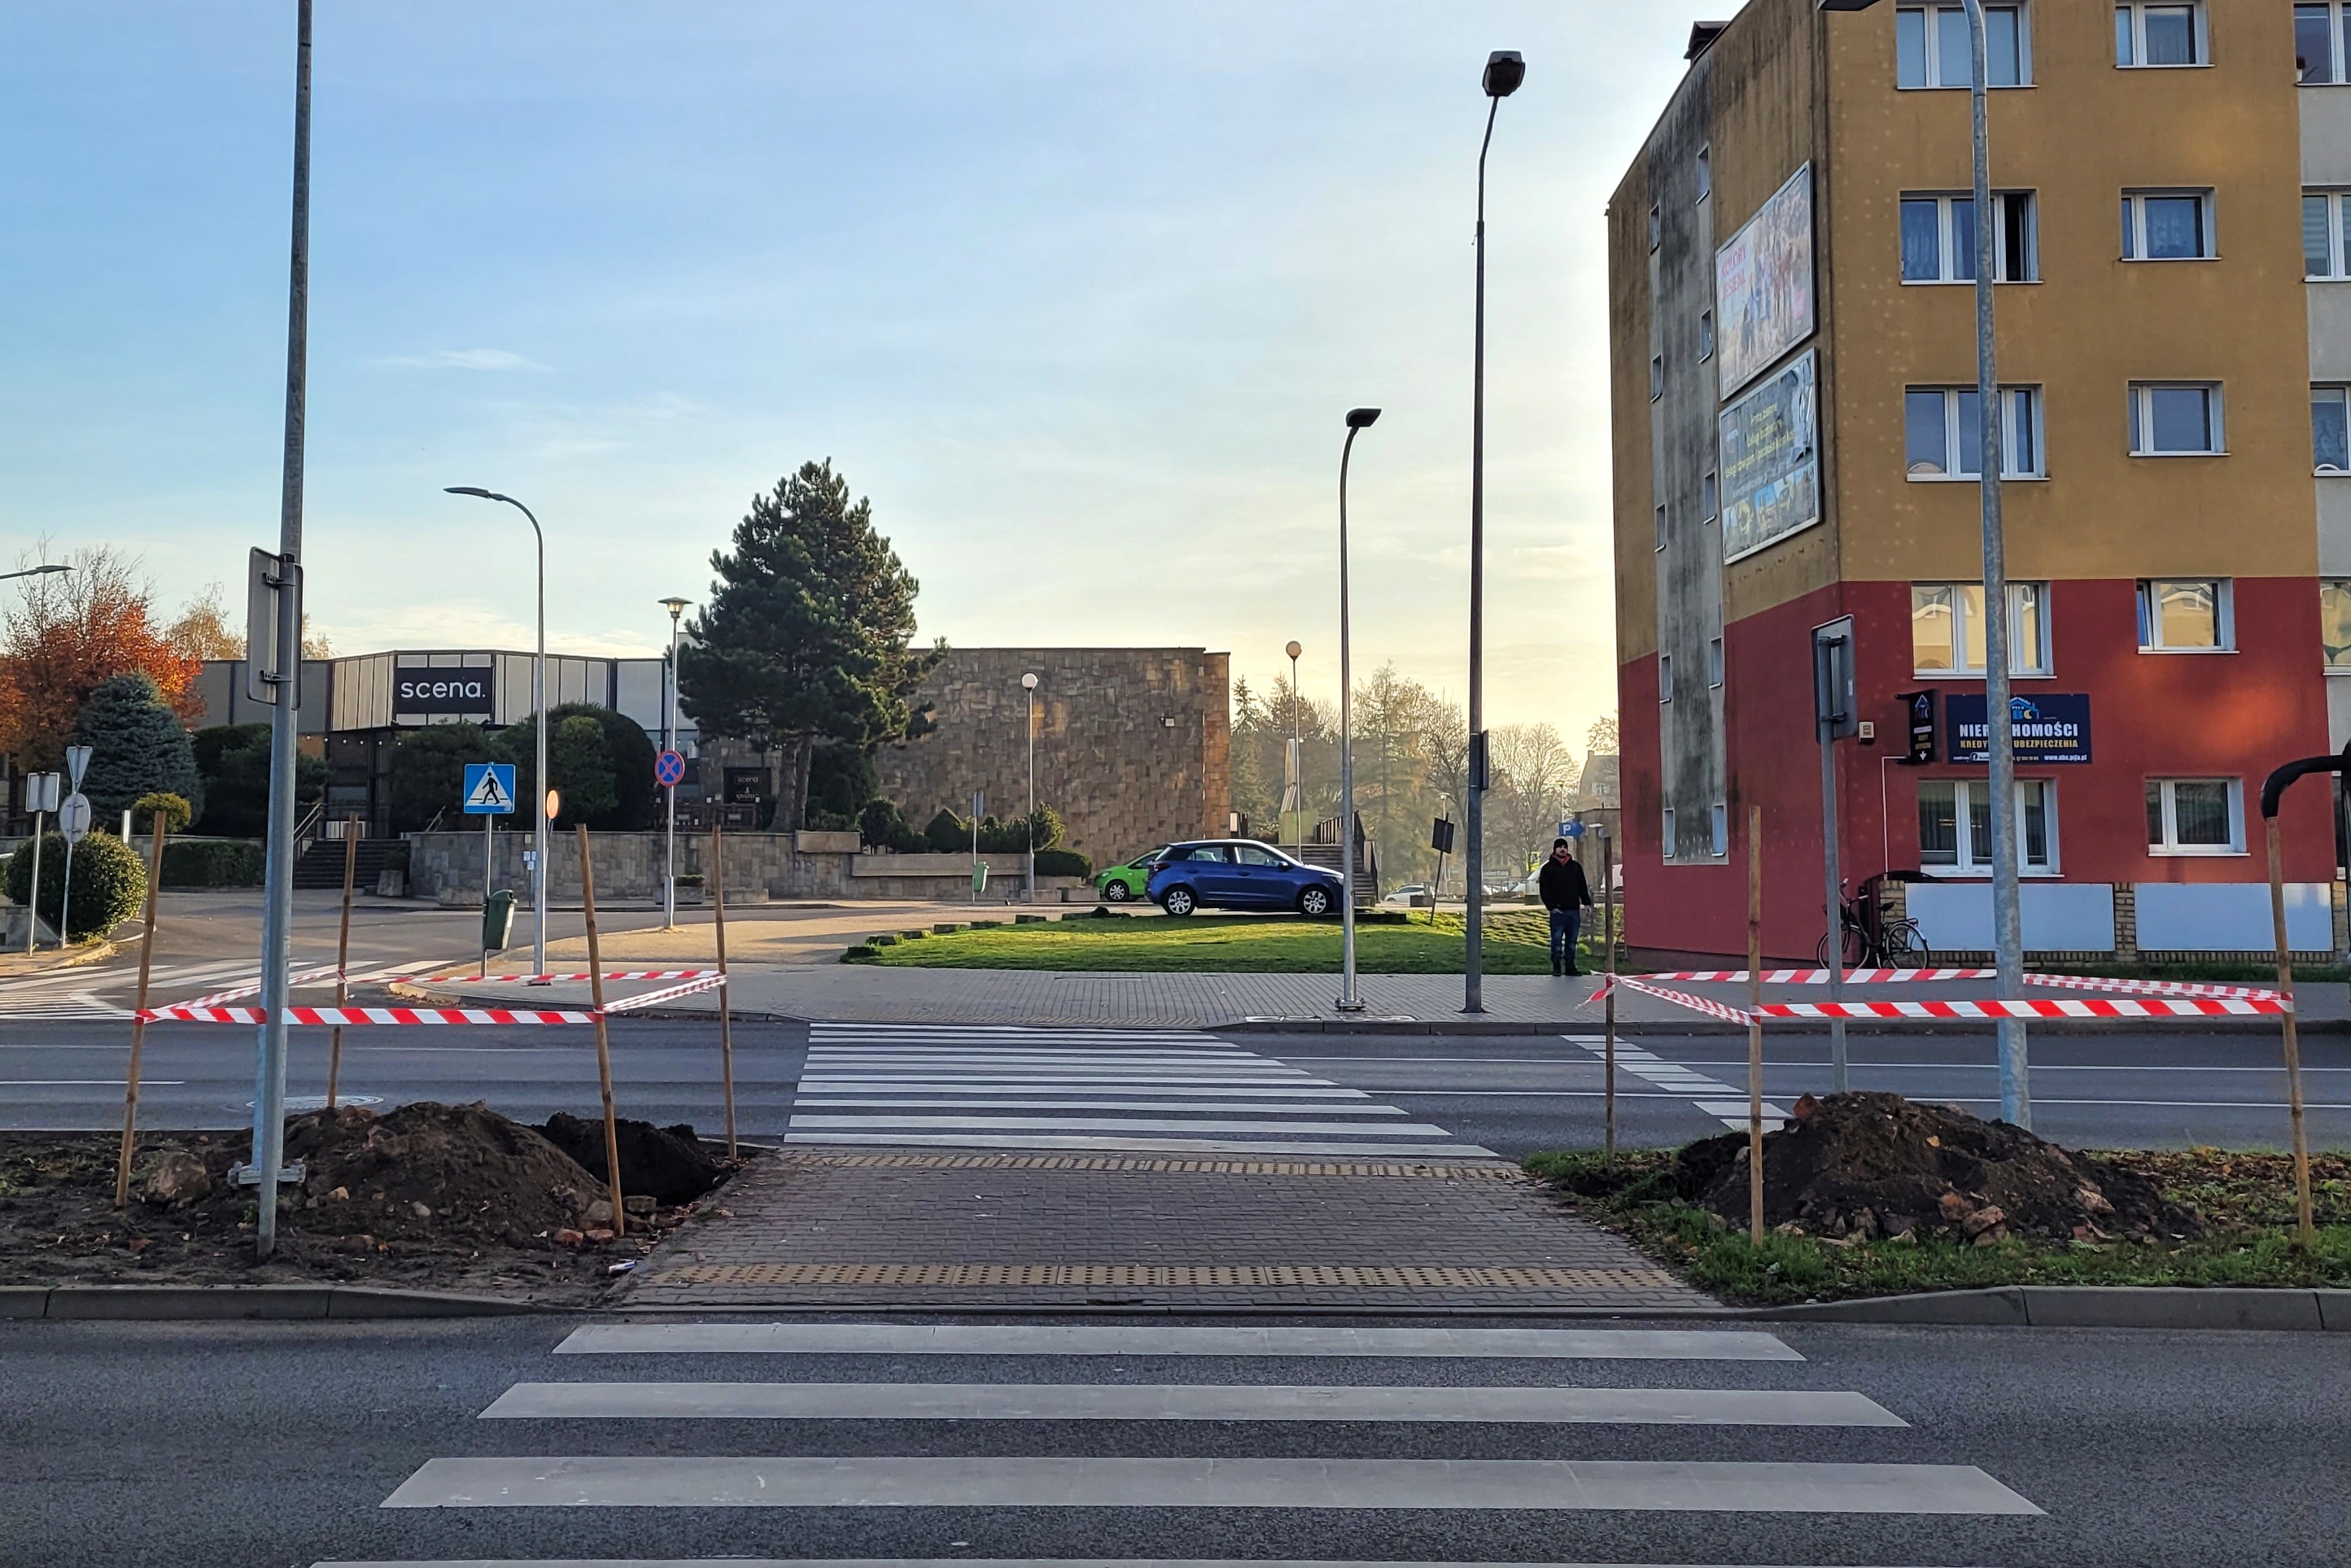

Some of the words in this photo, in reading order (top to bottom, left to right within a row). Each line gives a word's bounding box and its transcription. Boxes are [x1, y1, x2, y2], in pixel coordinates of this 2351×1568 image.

[400, 681, 486, 698] scena.
[1960, 721, 2078, 737] NIERHOMOŚCI
[2013, 739, 2078, 748] UBEZPIECZENIA
[1562, 824, 1571, 835] P
